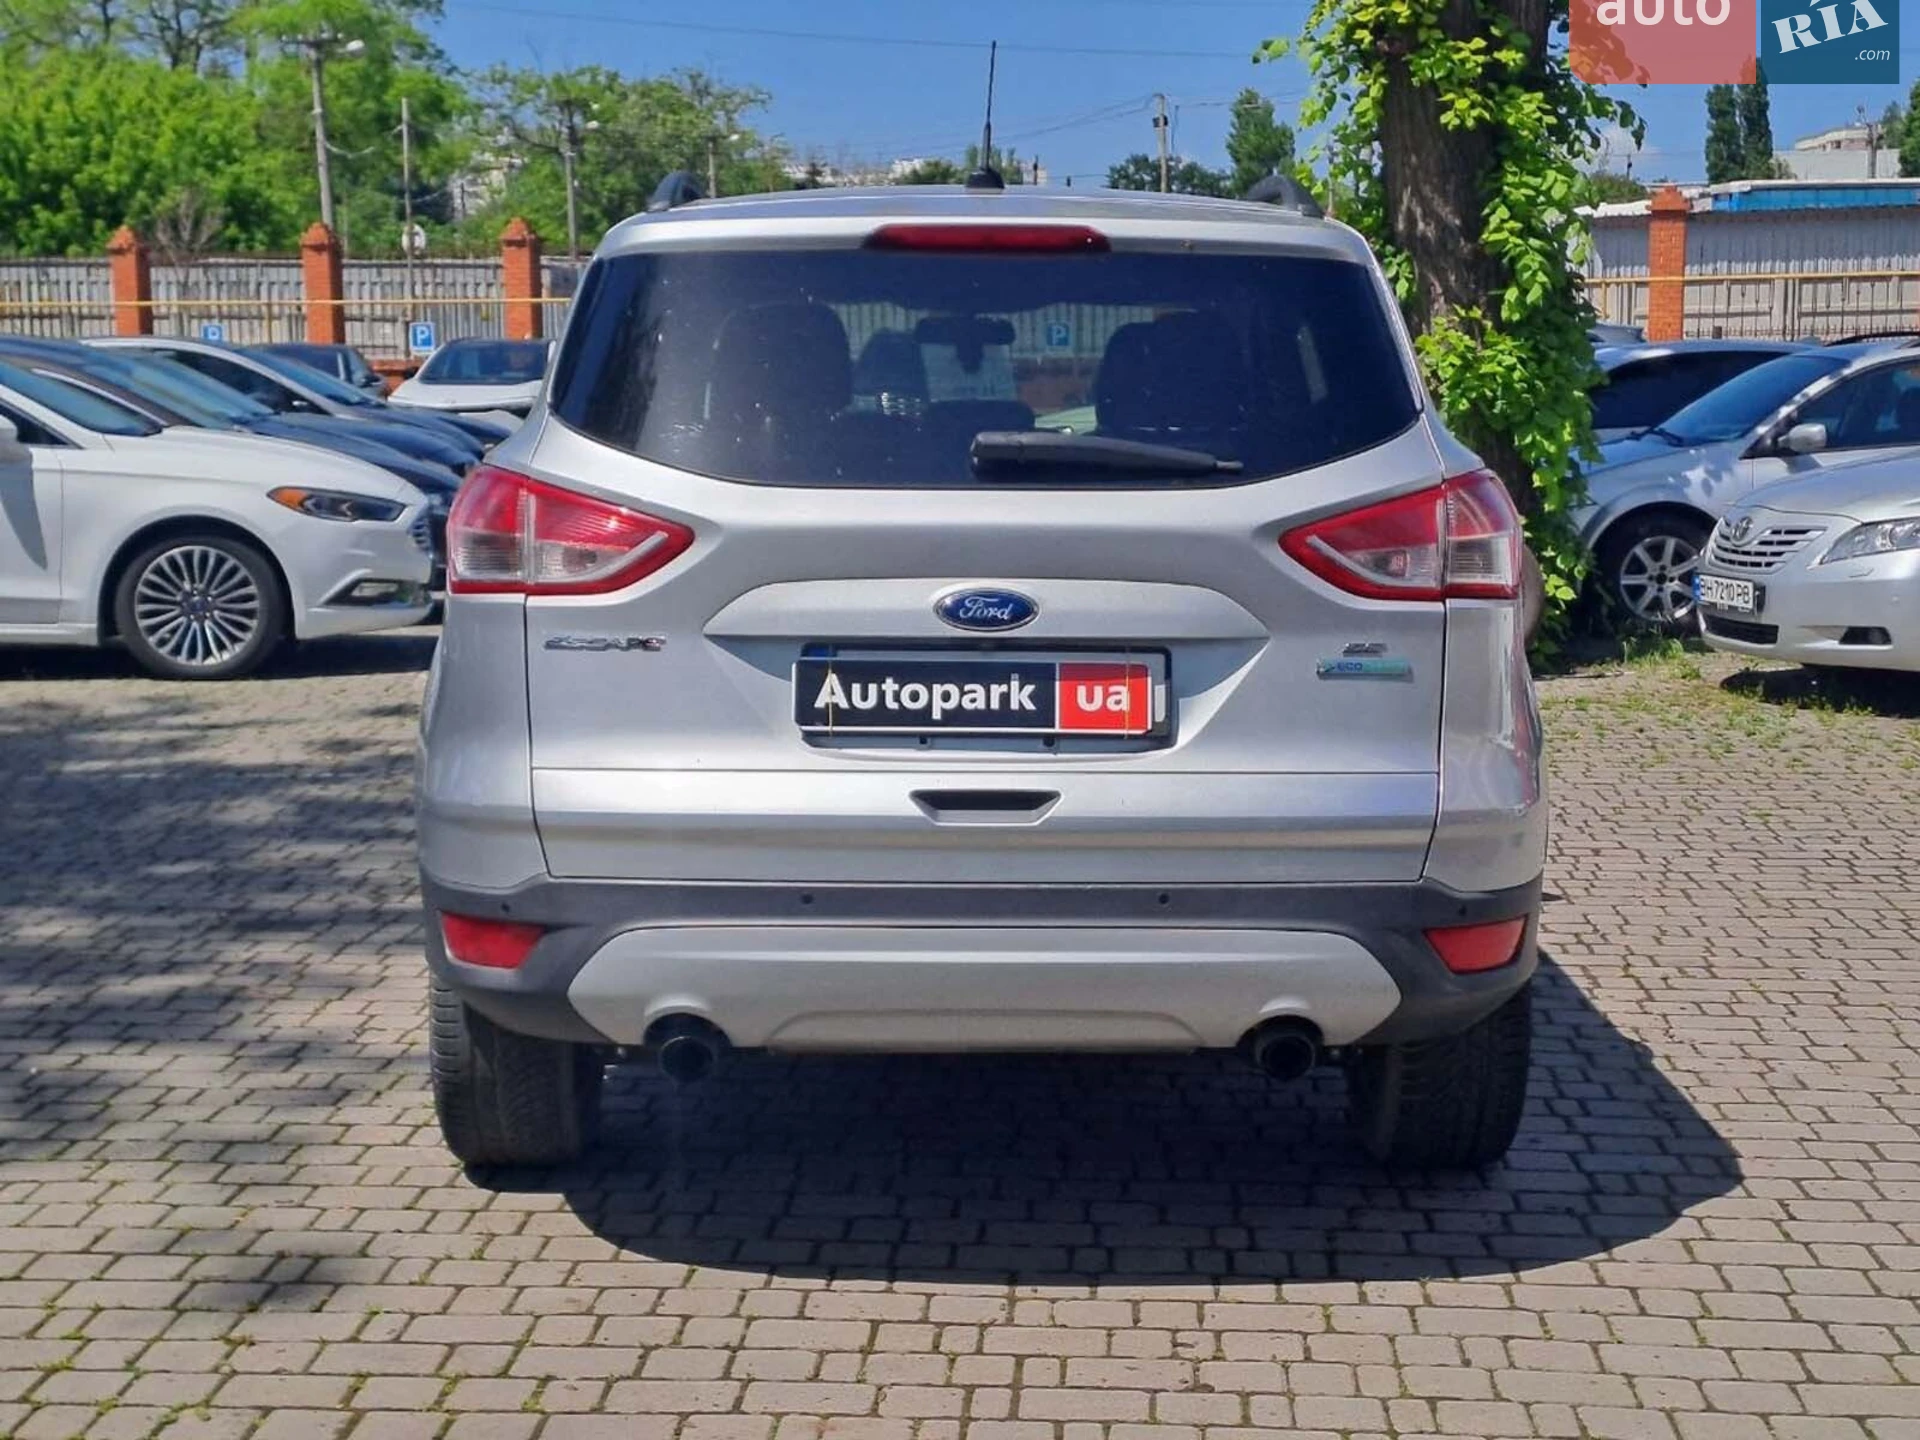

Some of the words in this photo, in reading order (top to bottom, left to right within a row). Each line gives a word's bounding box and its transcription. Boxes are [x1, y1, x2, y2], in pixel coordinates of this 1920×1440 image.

[416, 325, 430, 346] P
[1051, 325, 1067, 345] P
[959, 595, 1014, 620] Ford
[813, 672, 1037, 721] Autopark
[1075, 684, 1130, 712] ua
